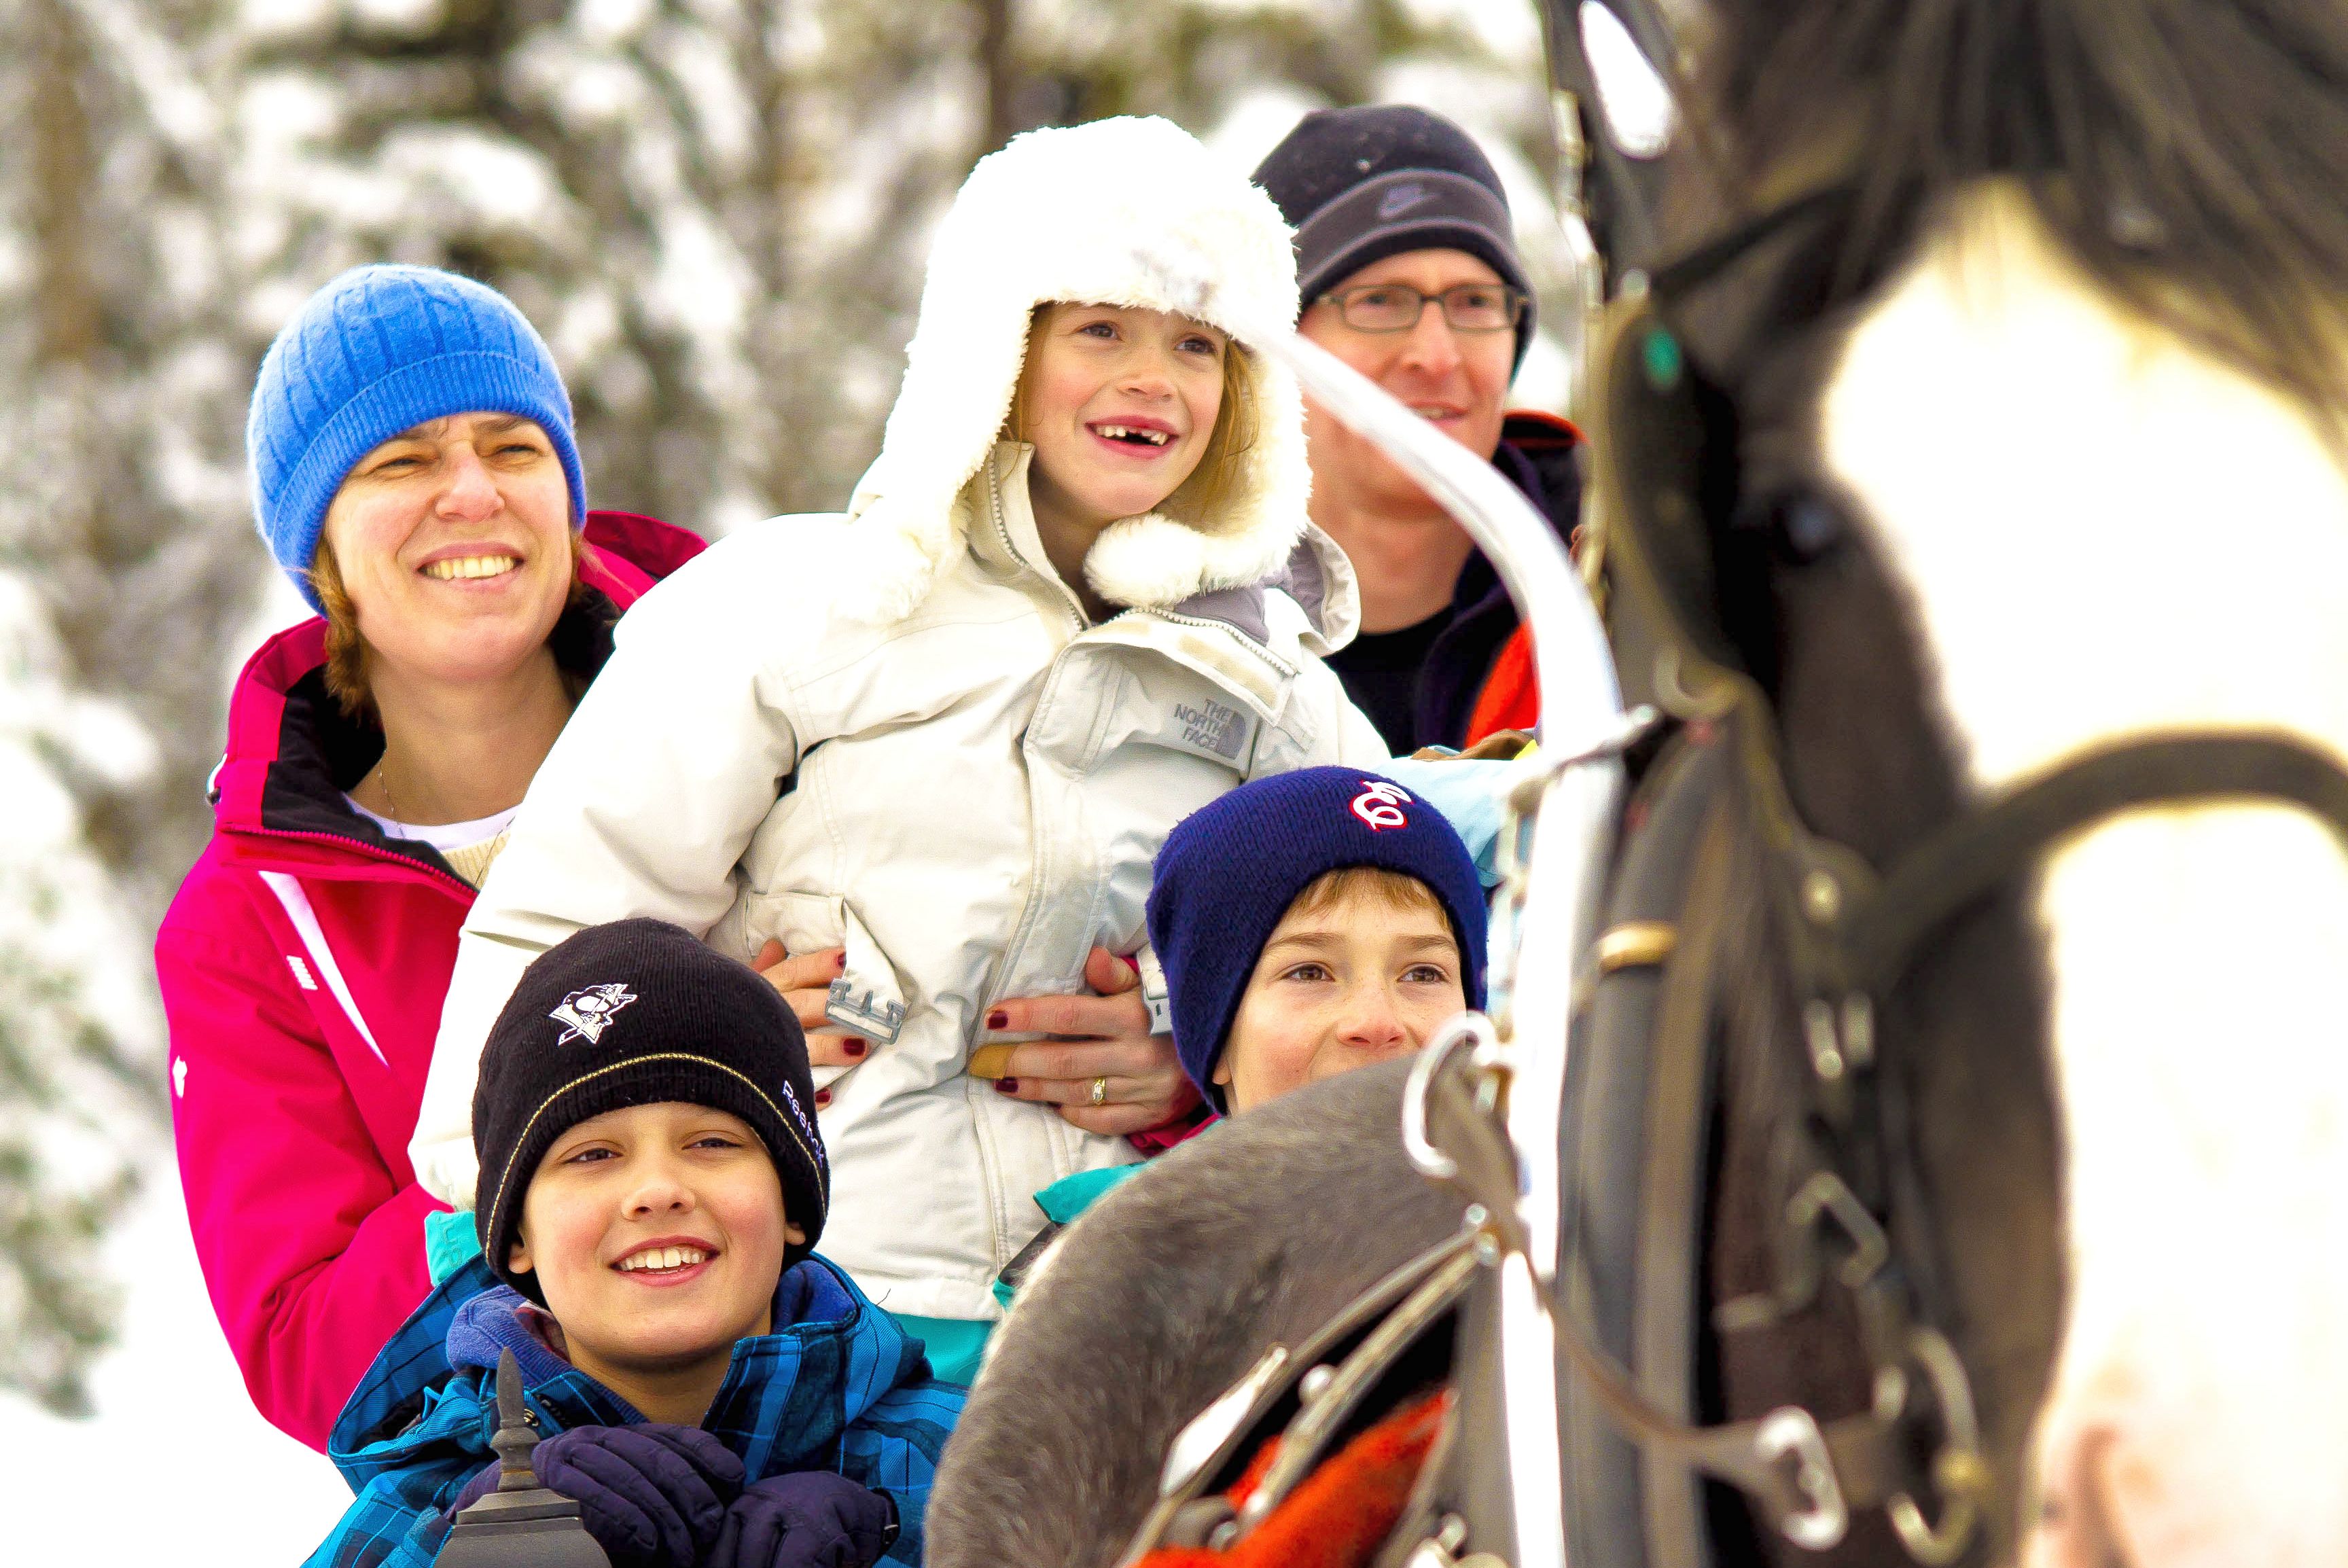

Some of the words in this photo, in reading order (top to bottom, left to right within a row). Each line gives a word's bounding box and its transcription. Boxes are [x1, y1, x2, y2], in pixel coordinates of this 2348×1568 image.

[1174, 704, 1223, 734] NORTH
[1204, 698, 1232, 722] THE
[1182, 726, 1219, 749] FACE
